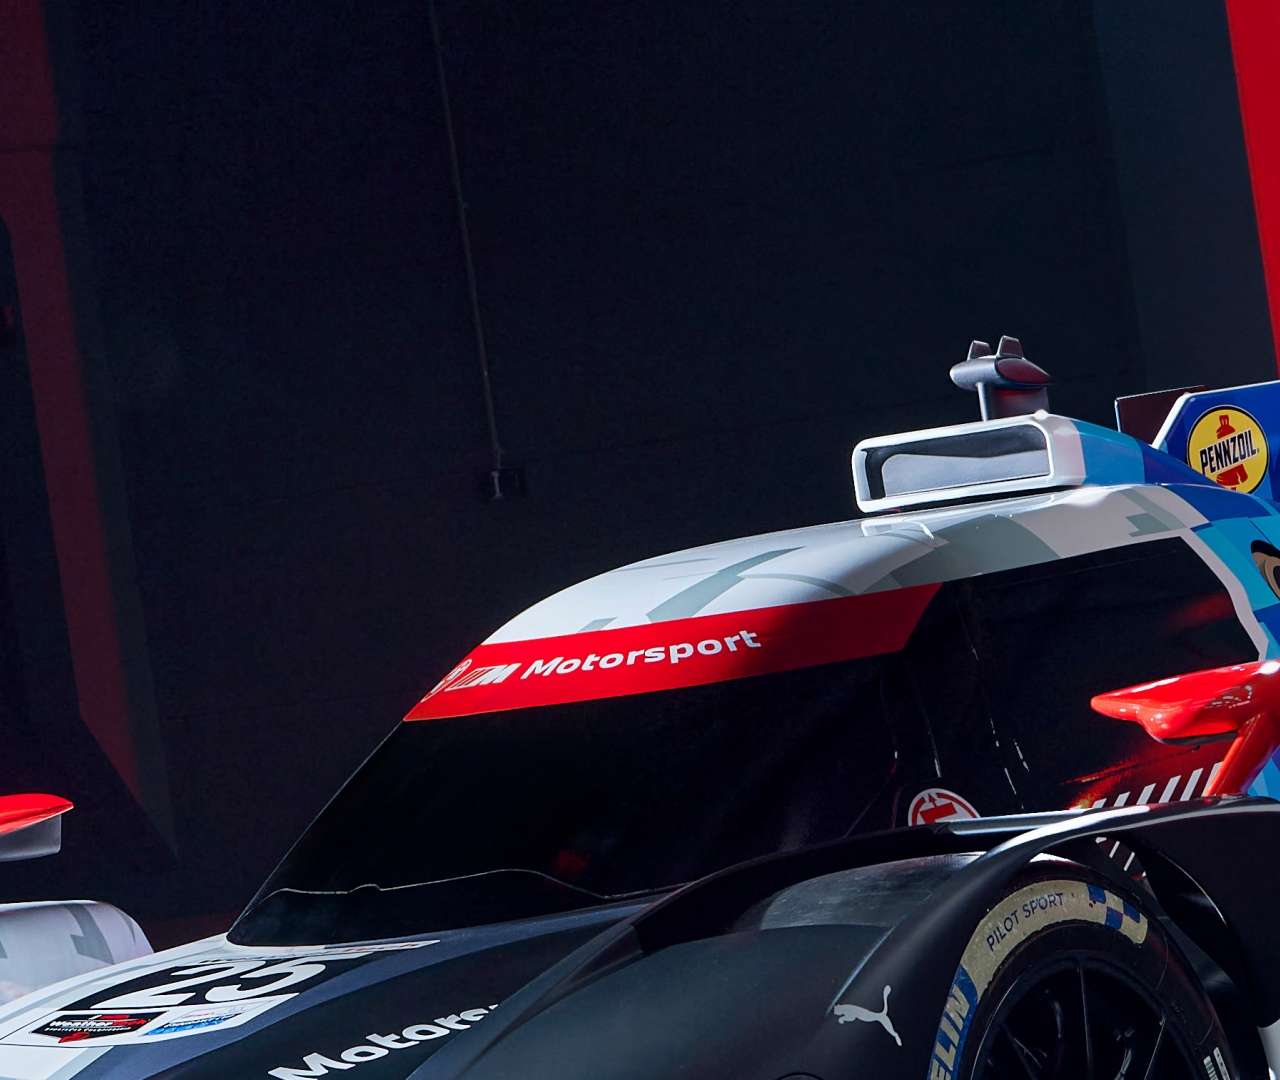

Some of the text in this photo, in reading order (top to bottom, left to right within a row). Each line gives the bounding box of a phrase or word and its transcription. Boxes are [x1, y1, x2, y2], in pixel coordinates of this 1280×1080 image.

[1199, 429, 1257, 476] PENNZOIL
[521, 630, 762, 680] Motorsport
[986, 892, 1064, 952] PILOT SPORT
[90, 952, 374, 1009] 25
